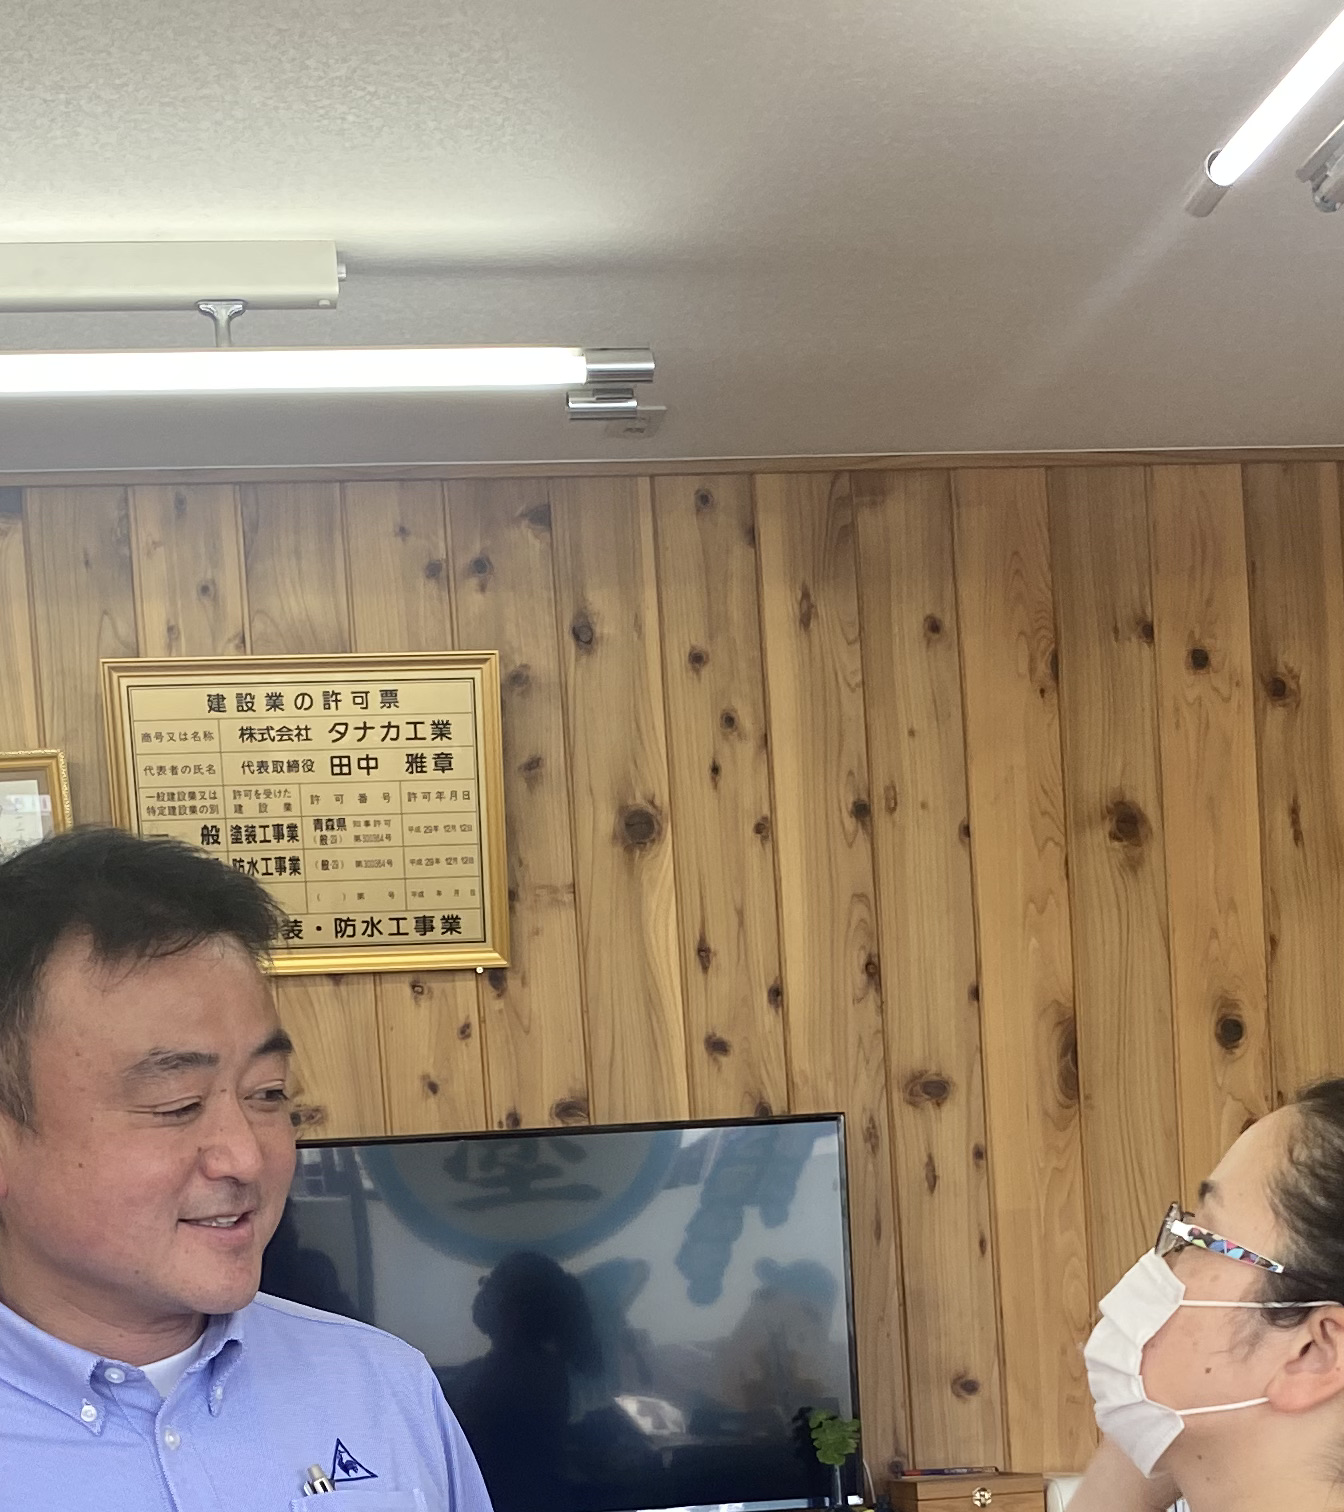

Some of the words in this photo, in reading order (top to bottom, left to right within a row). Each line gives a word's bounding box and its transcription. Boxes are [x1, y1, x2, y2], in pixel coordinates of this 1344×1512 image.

[207, 688, 400, 713] 建設業の許可票
[141, 730, 214, 743] 商号又は名称
[238, 724, 313, 743] 株式会社
[328, 719, 453, 743] タナカ工業
[143, 763, 216, 777] 代表者の氏名
[241, 758, 315, 775] 代表取締役
[330, 754, 379, 776] 田中
[405, 751, 454, 775] 雅章
[145, 789, 218, 802] 一般建設業又は
[232, 788, 292, 800] 許可を受けた
[407, 790, 471, 803] 許可年月日
[146, 804, 219, 816] 特定建設業の別
[313, 818, 347, 832] 青森県
[230, 823, 300, 844] 塗装工事業
[232, 856, 301, 876] 防水工事業
[274, 914, 462, 940] 装・防水工事業
